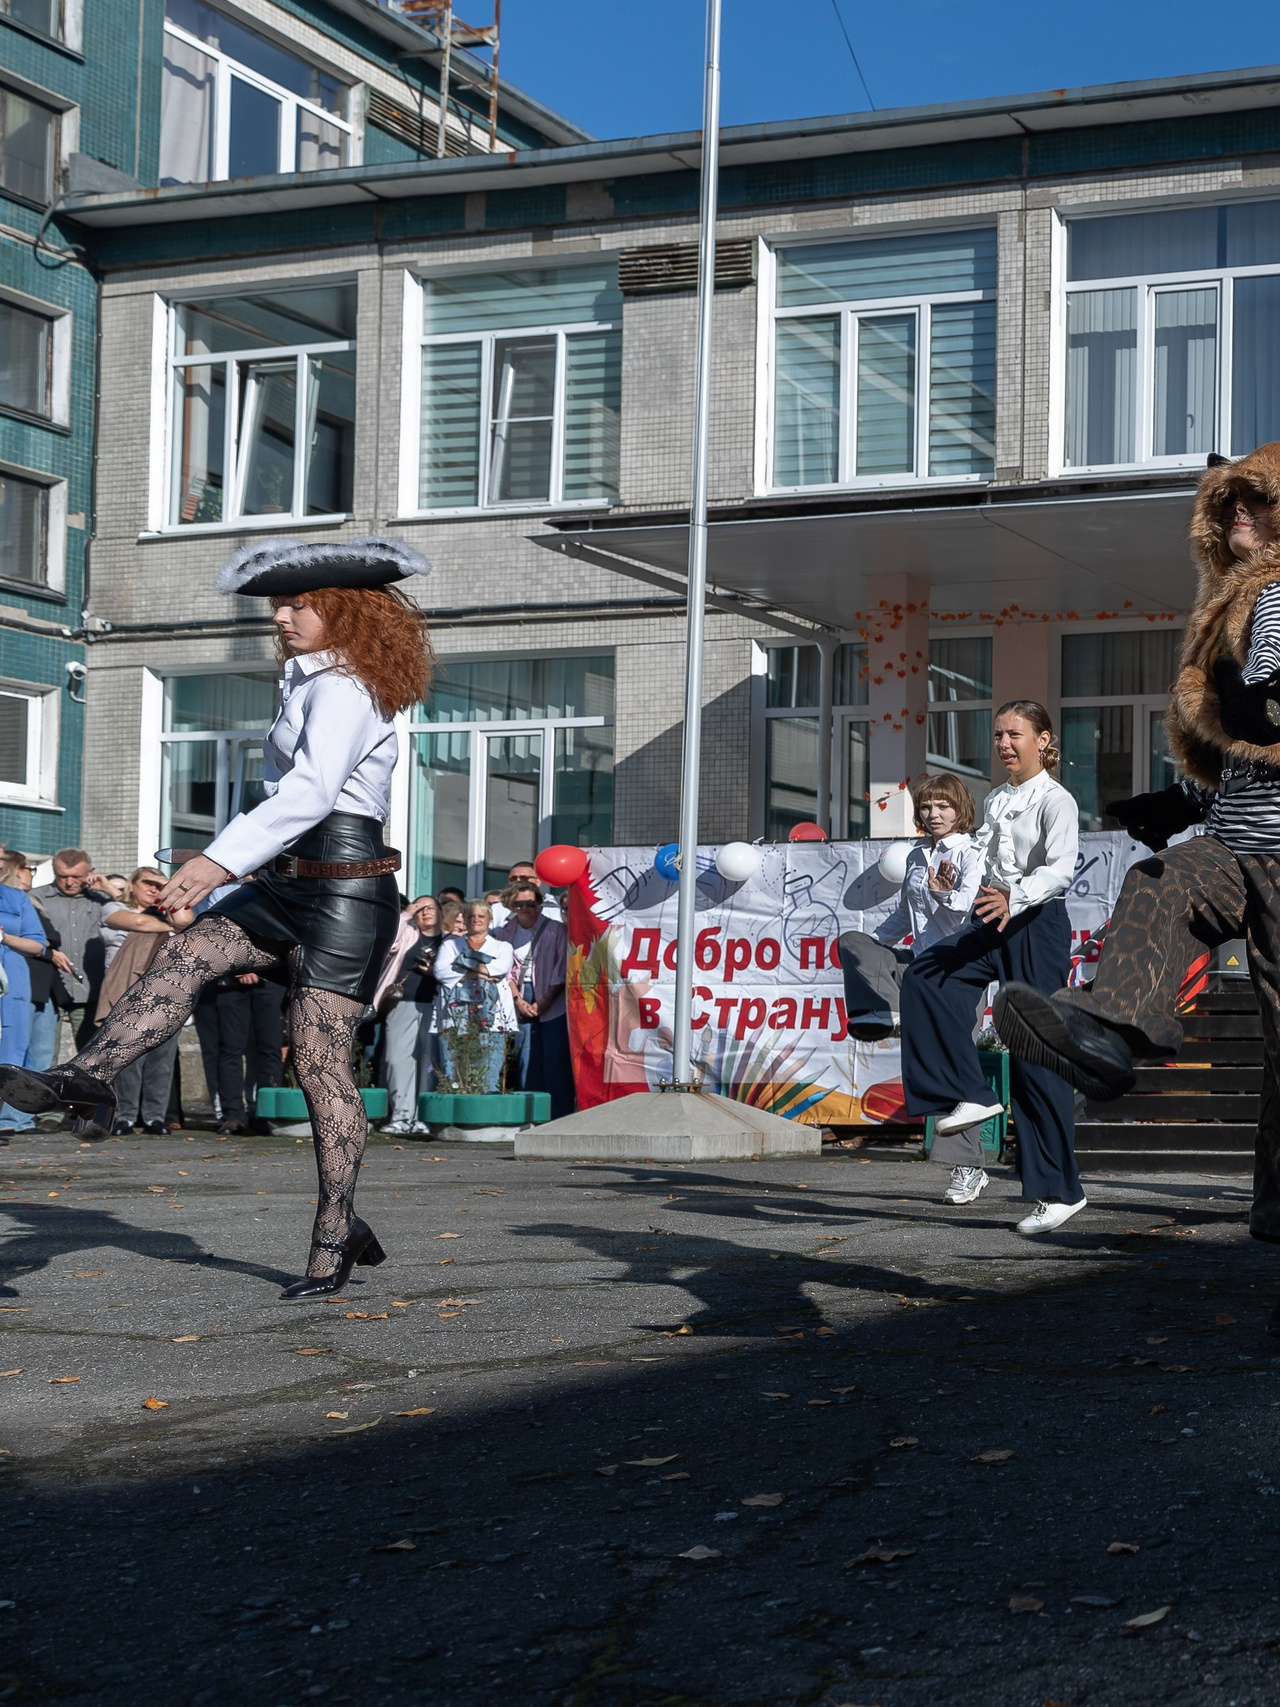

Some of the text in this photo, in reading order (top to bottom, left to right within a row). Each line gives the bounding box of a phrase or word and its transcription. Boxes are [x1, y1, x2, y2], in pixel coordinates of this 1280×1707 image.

[620, 926, 780, 982] Добро
[639, 986, 849, 1041] в Страну
